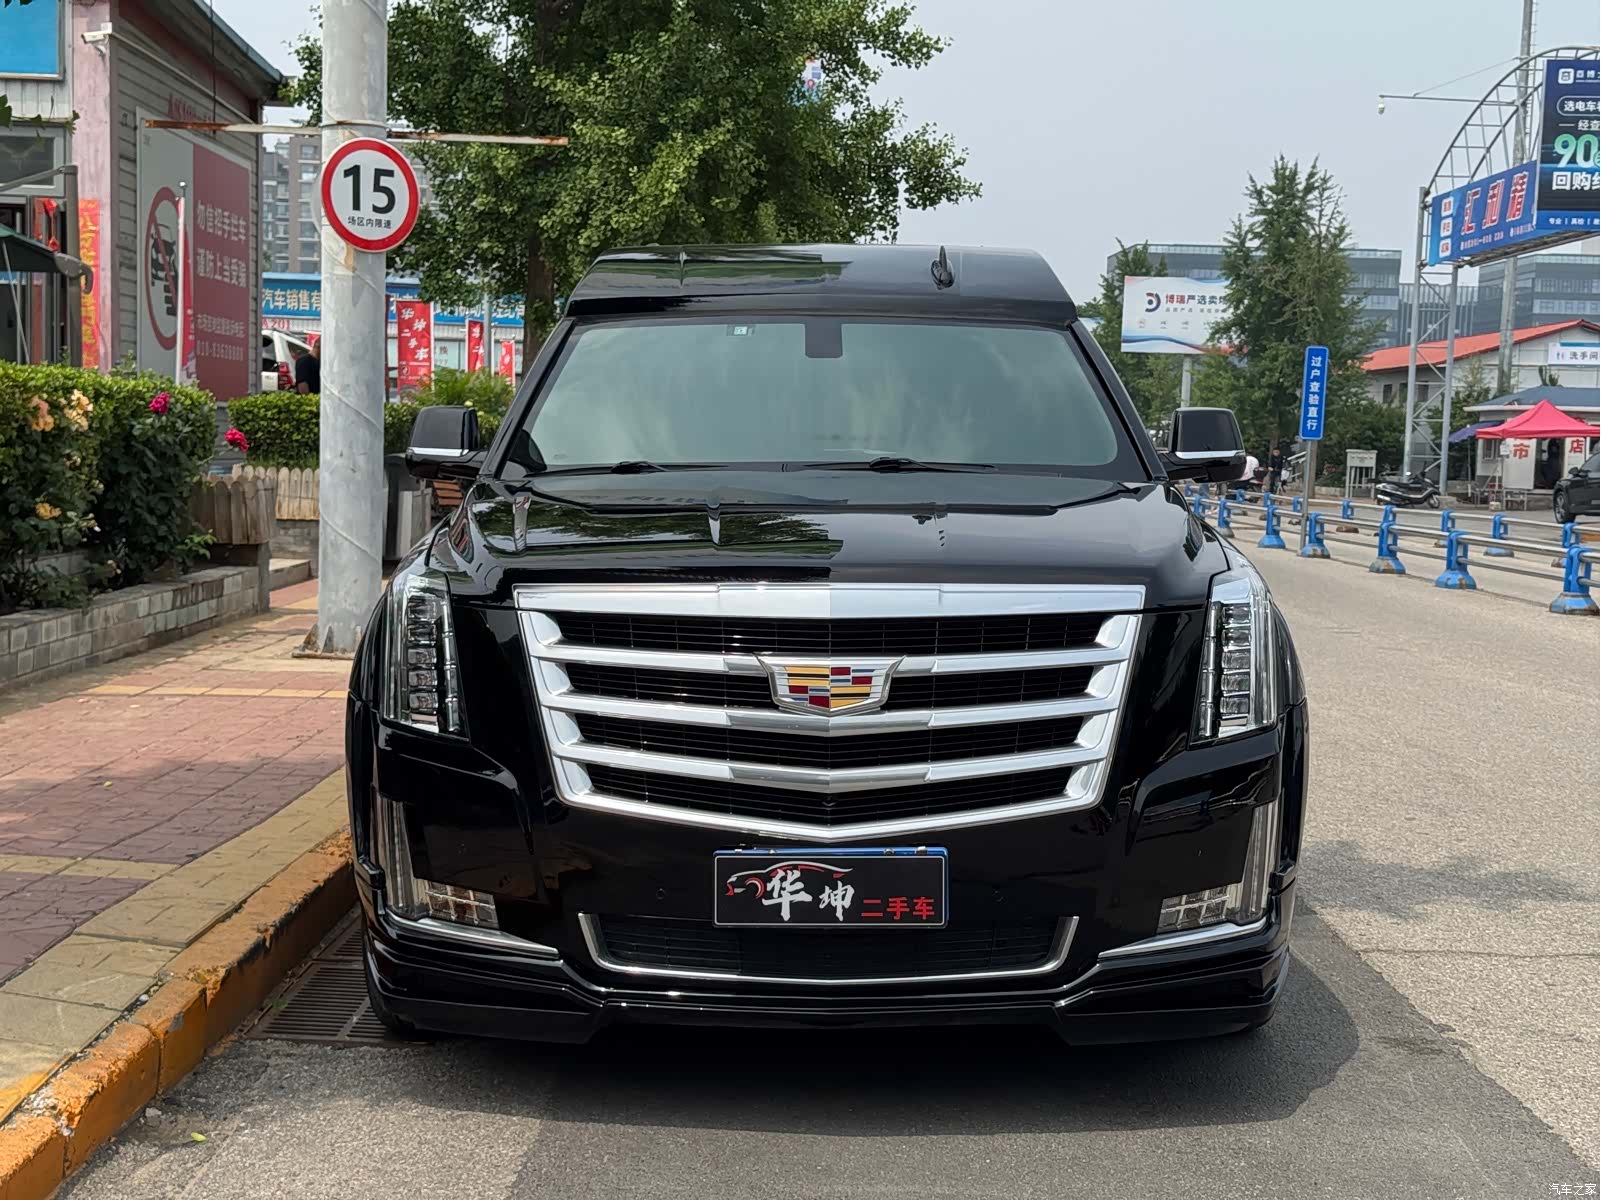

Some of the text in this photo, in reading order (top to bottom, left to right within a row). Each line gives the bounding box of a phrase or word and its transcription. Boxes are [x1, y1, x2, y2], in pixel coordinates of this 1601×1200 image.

[1554, 133, 1598, 168] 90
[343, 164, 396, 215] 15
[347, 216, 392, 230] 场区内限速
[1306, 355, 1323, 431] 过户查验直行
[1513, 439, 1584, 459] 市 店
[762, 869, 935, 921] 华坤 二手车
